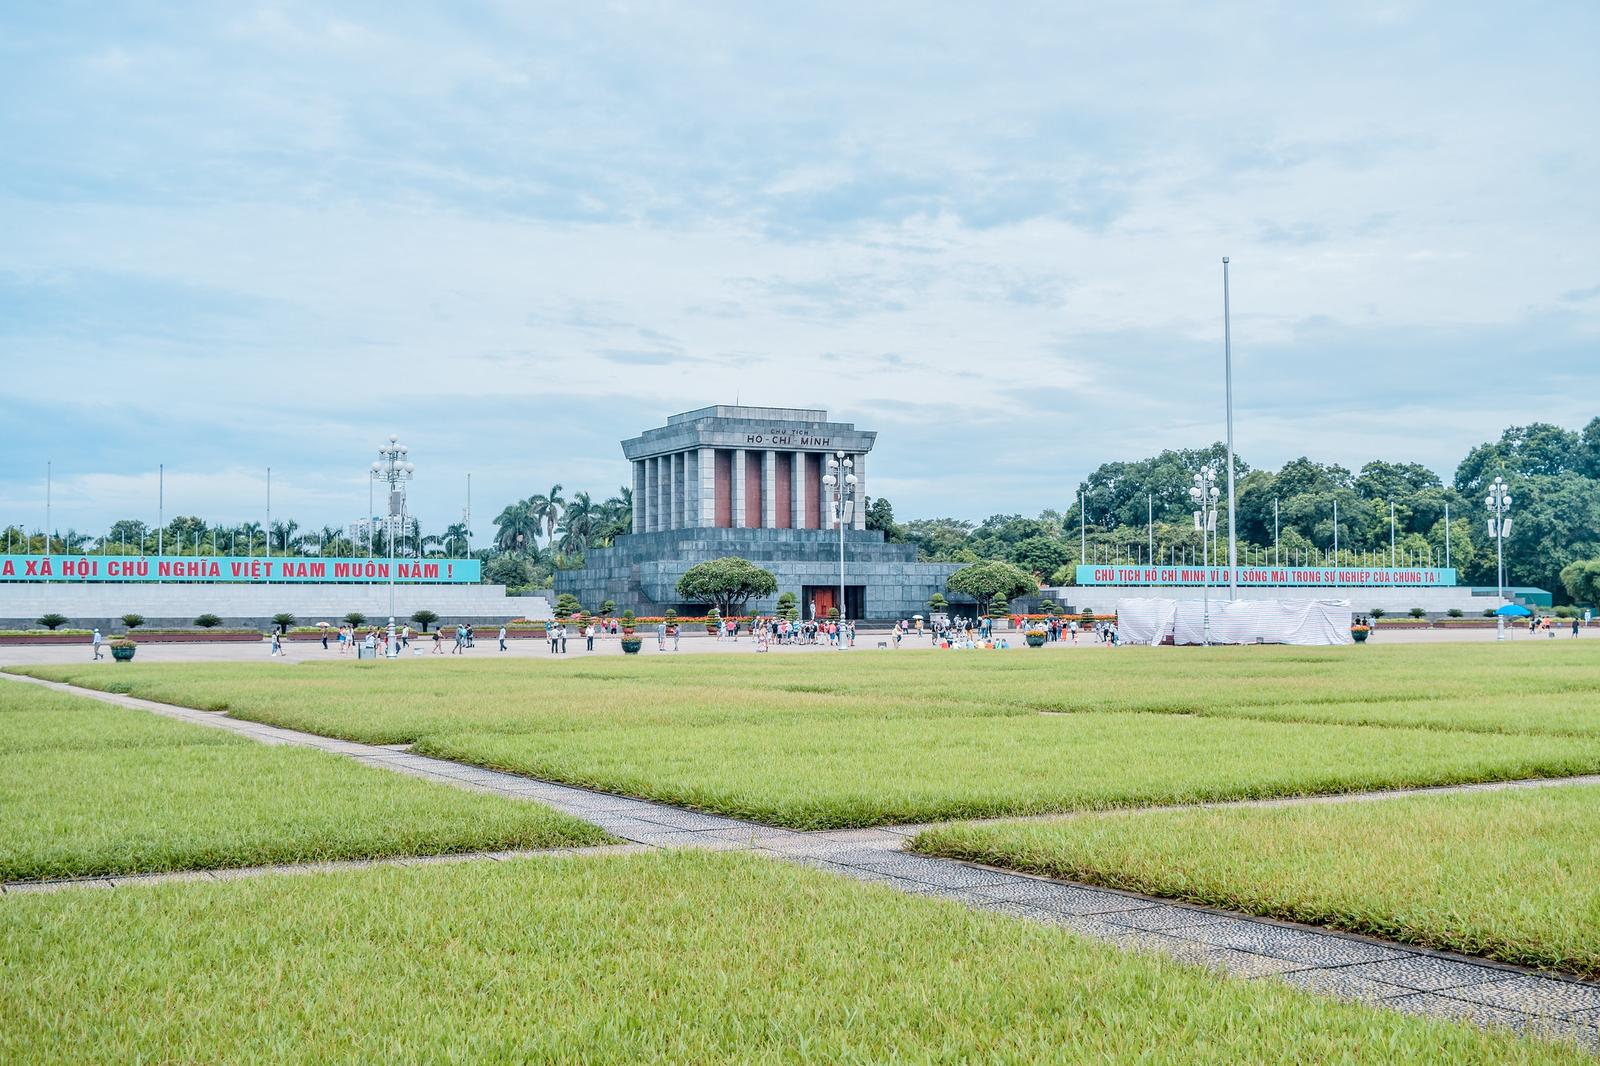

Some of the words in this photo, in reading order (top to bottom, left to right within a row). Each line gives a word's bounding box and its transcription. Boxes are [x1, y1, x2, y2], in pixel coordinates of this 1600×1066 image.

[25, 558, 53, 576] XÃ
[62, 558, 98, 579] HỘI
[107, 557, 148, 576] CHỦ
[158, 559, 221, 577] NGHĨA
[231, 559, 273, 579] VIỆT
[282, 562, 325, 577] NAM
[334, 560, 389, 578] MUÔN
[398, 561, 439, 578] NĂM
[1095, 566, 1114, 582] CHỦ
[1119, 569, 1140, 584] TỊCH
[1182, 570, 1206, 582] MINH
[1223, 570, 1239, 582] ĐI
[1243, 568, 1267, 582] SỐNG
[1291, 570, 1321, 582] TRONG
[1393, 569, 1421, 583] CHÚNG
[1424, 571, 1434, 583] TA
